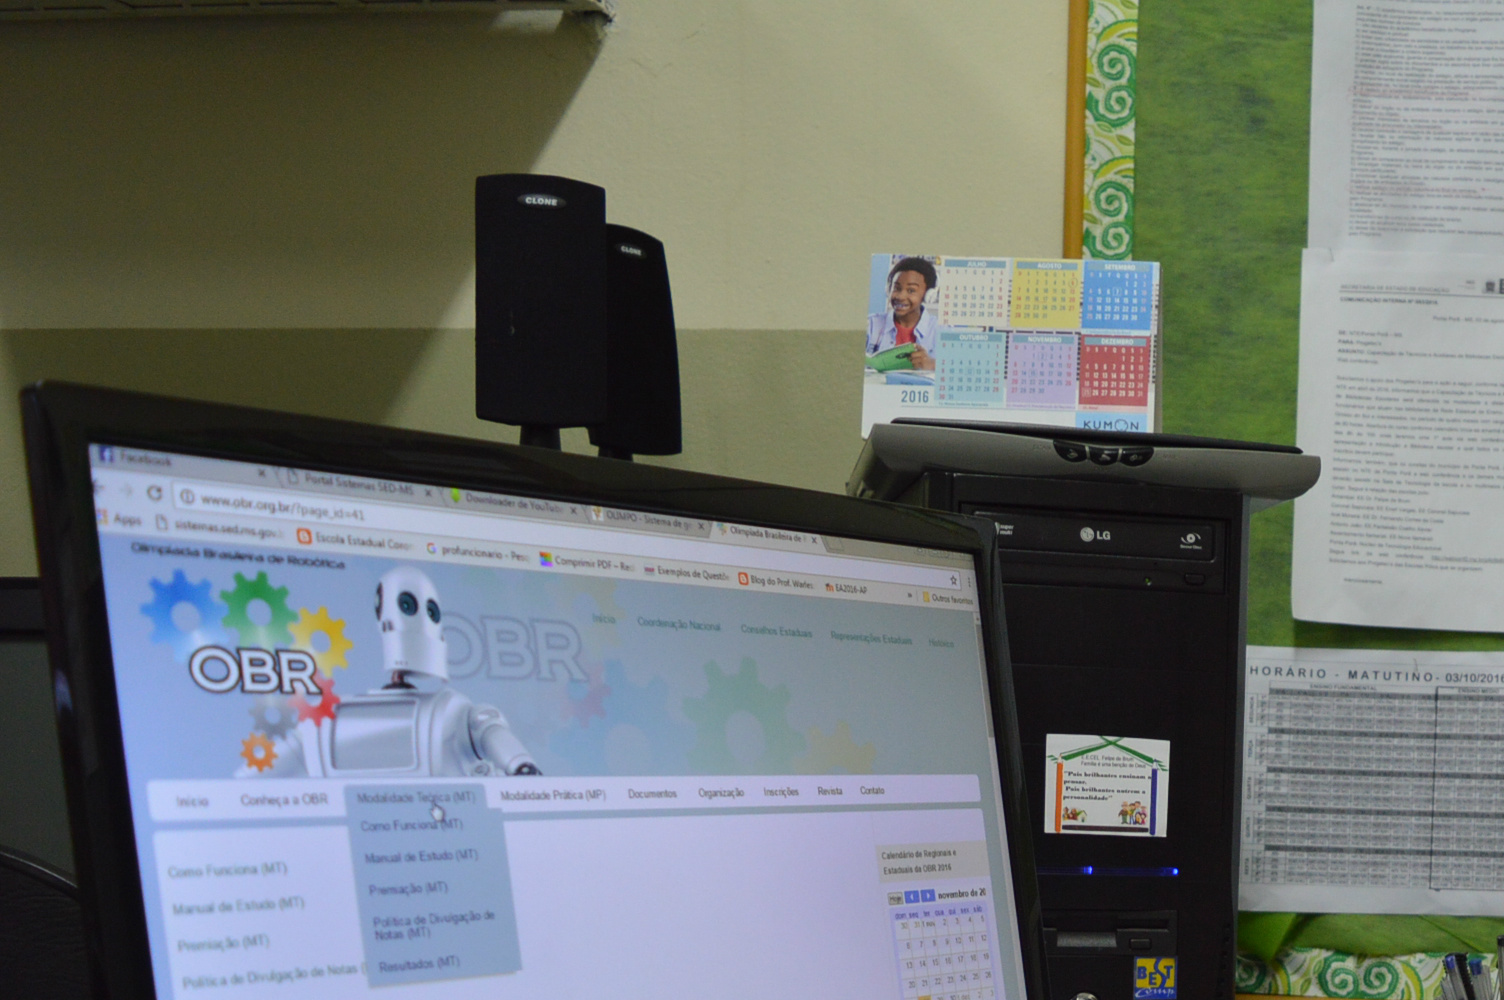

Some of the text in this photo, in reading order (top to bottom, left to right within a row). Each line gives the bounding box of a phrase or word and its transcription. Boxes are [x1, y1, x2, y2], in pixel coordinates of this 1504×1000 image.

[525, 196, 558, 206] CLONE
[620, 244, 642, 256] CLONE
[1037, 262, 1062, 270] AGOSTO
[1104, 263, 1136, 271] SETEMBRO
[1028, 335, 1062, 344] NOVEMBRO
[901, 389, 929, 404] 2016
[1083, 418, 1140, 433] KUMON
[120, 450, 172, 467] Facebook
[305, 472, 334, 486] Portal
[335, 474, 376, 491] Sistemas
[114, 512, 142, 527] Apps
[643, 514, 672, 528] Sistema
[316, 531, 386, 549] Escola Estadual
[555, 555, 612, 569] Comprimir PDF
[657, 565, 691, 579] Exemplos
[750, 575, 791, 588] Blog do Prof.
[637, 617, 721, 632] Coordenação Nacional
[741, 624, 778, 636] Conselhos
[446, 610, 589, 683] OBR
[189, 644, 323, 697] OBR
[1250, 663, 1327, 679] HORÁRIO
[1348, 669, 1433, 682] MATUTINO
[500, 790, 551, 801] Modalidade
[553, 788, 584, 801] Prática
[628, 787, 677, 800] Documentos
[698, 786, 745, 800] Organização
[763, 786, 799, 798] Inscrições
[817, 785, 843, 796] Revista
[860, 785, 885, 796] Contato
[240, 793, 328, 810] Conheça OBR
[360, 819, 438, 833] Como Funciona
[365, 848, 479, 864] Manual de Estudo (MT)
[881, 848, 952, 860] Calendário Regionais
[167, 862, 288, 879] Como Funciona (MT)
[883, 865, 914, 875] Estaduais
[938, 863, 952, 872] 2016
[938, 888, 979, 900] novembro de
[172, 901, 215, 915] Manual
[218, 901, 233, 913] de
[236, 898, 276, 911] Estudo
[374, 928, 405, 941] Notas
[379, 957, 434, 973] Resultados
[1137, 957, 1173, 987] BEST
